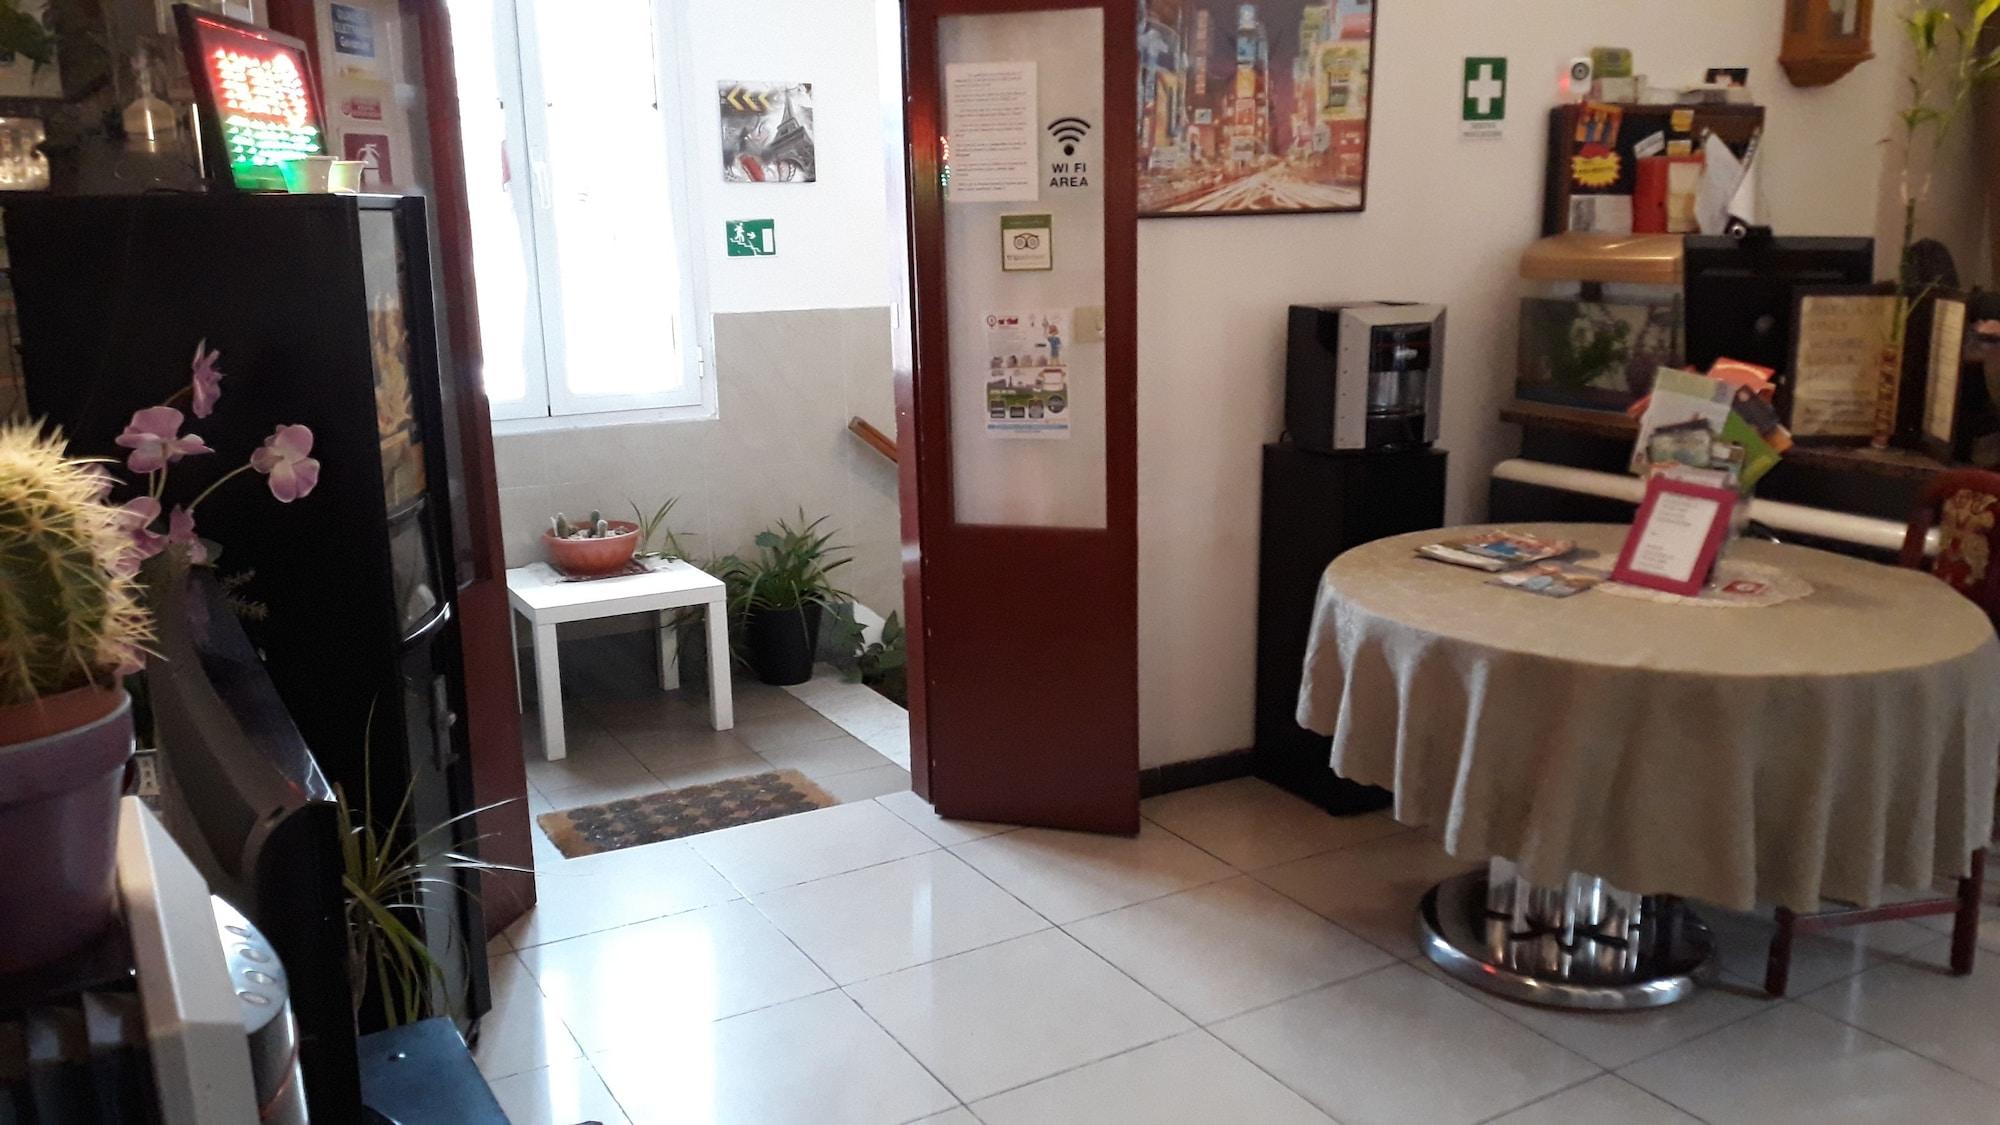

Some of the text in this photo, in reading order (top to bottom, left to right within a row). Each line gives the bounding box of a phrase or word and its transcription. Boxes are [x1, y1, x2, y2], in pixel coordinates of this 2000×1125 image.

[1051, 163, 1086, 173] WI FI
[1049, 177, 1088, 187] AREA
